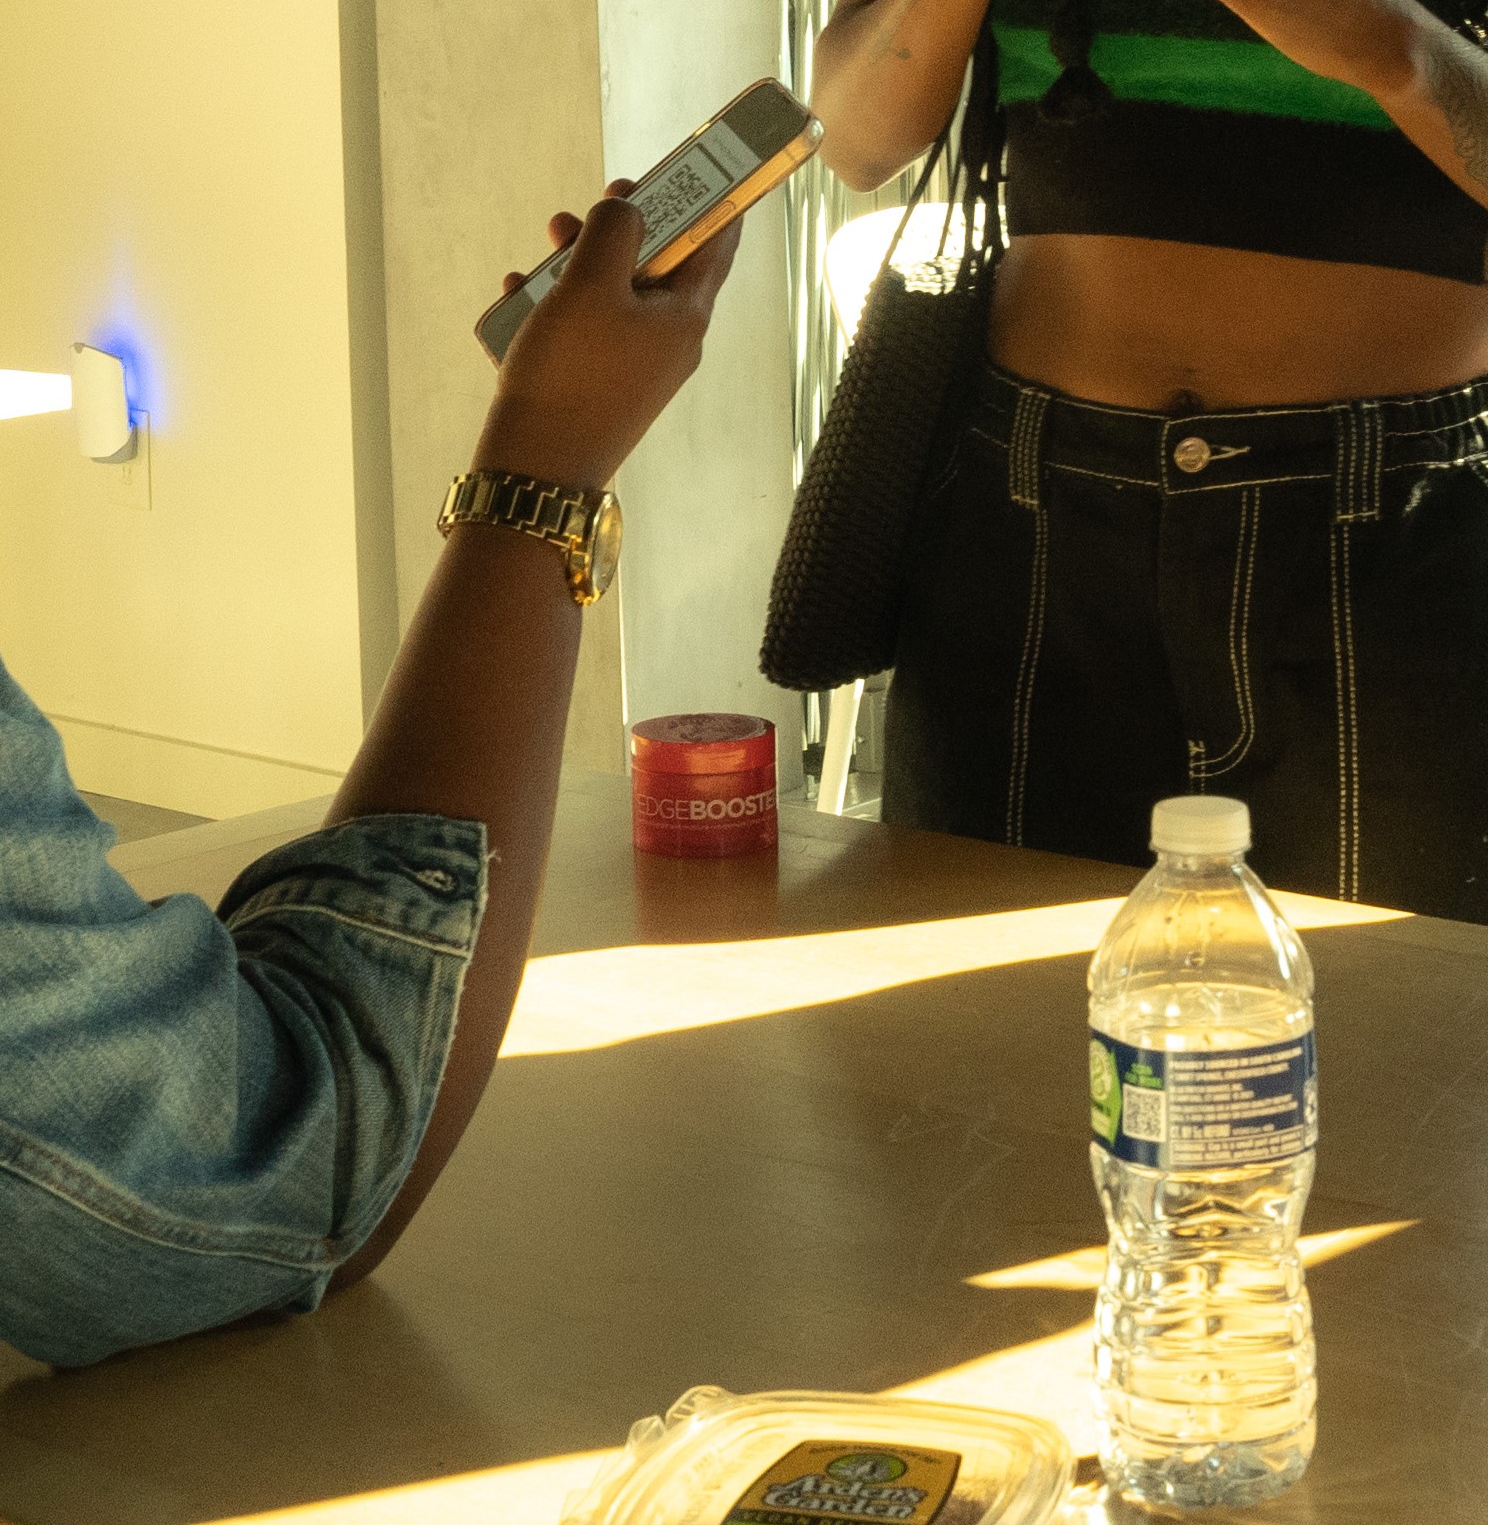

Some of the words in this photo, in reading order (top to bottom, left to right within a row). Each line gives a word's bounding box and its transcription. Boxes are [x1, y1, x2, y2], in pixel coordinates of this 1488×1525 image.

[637, 789, 776, 821] EDGEBOOSTE
[769, 1474, 927, 1504] Arden's
[763, 1490, 915, 1519] Garden
